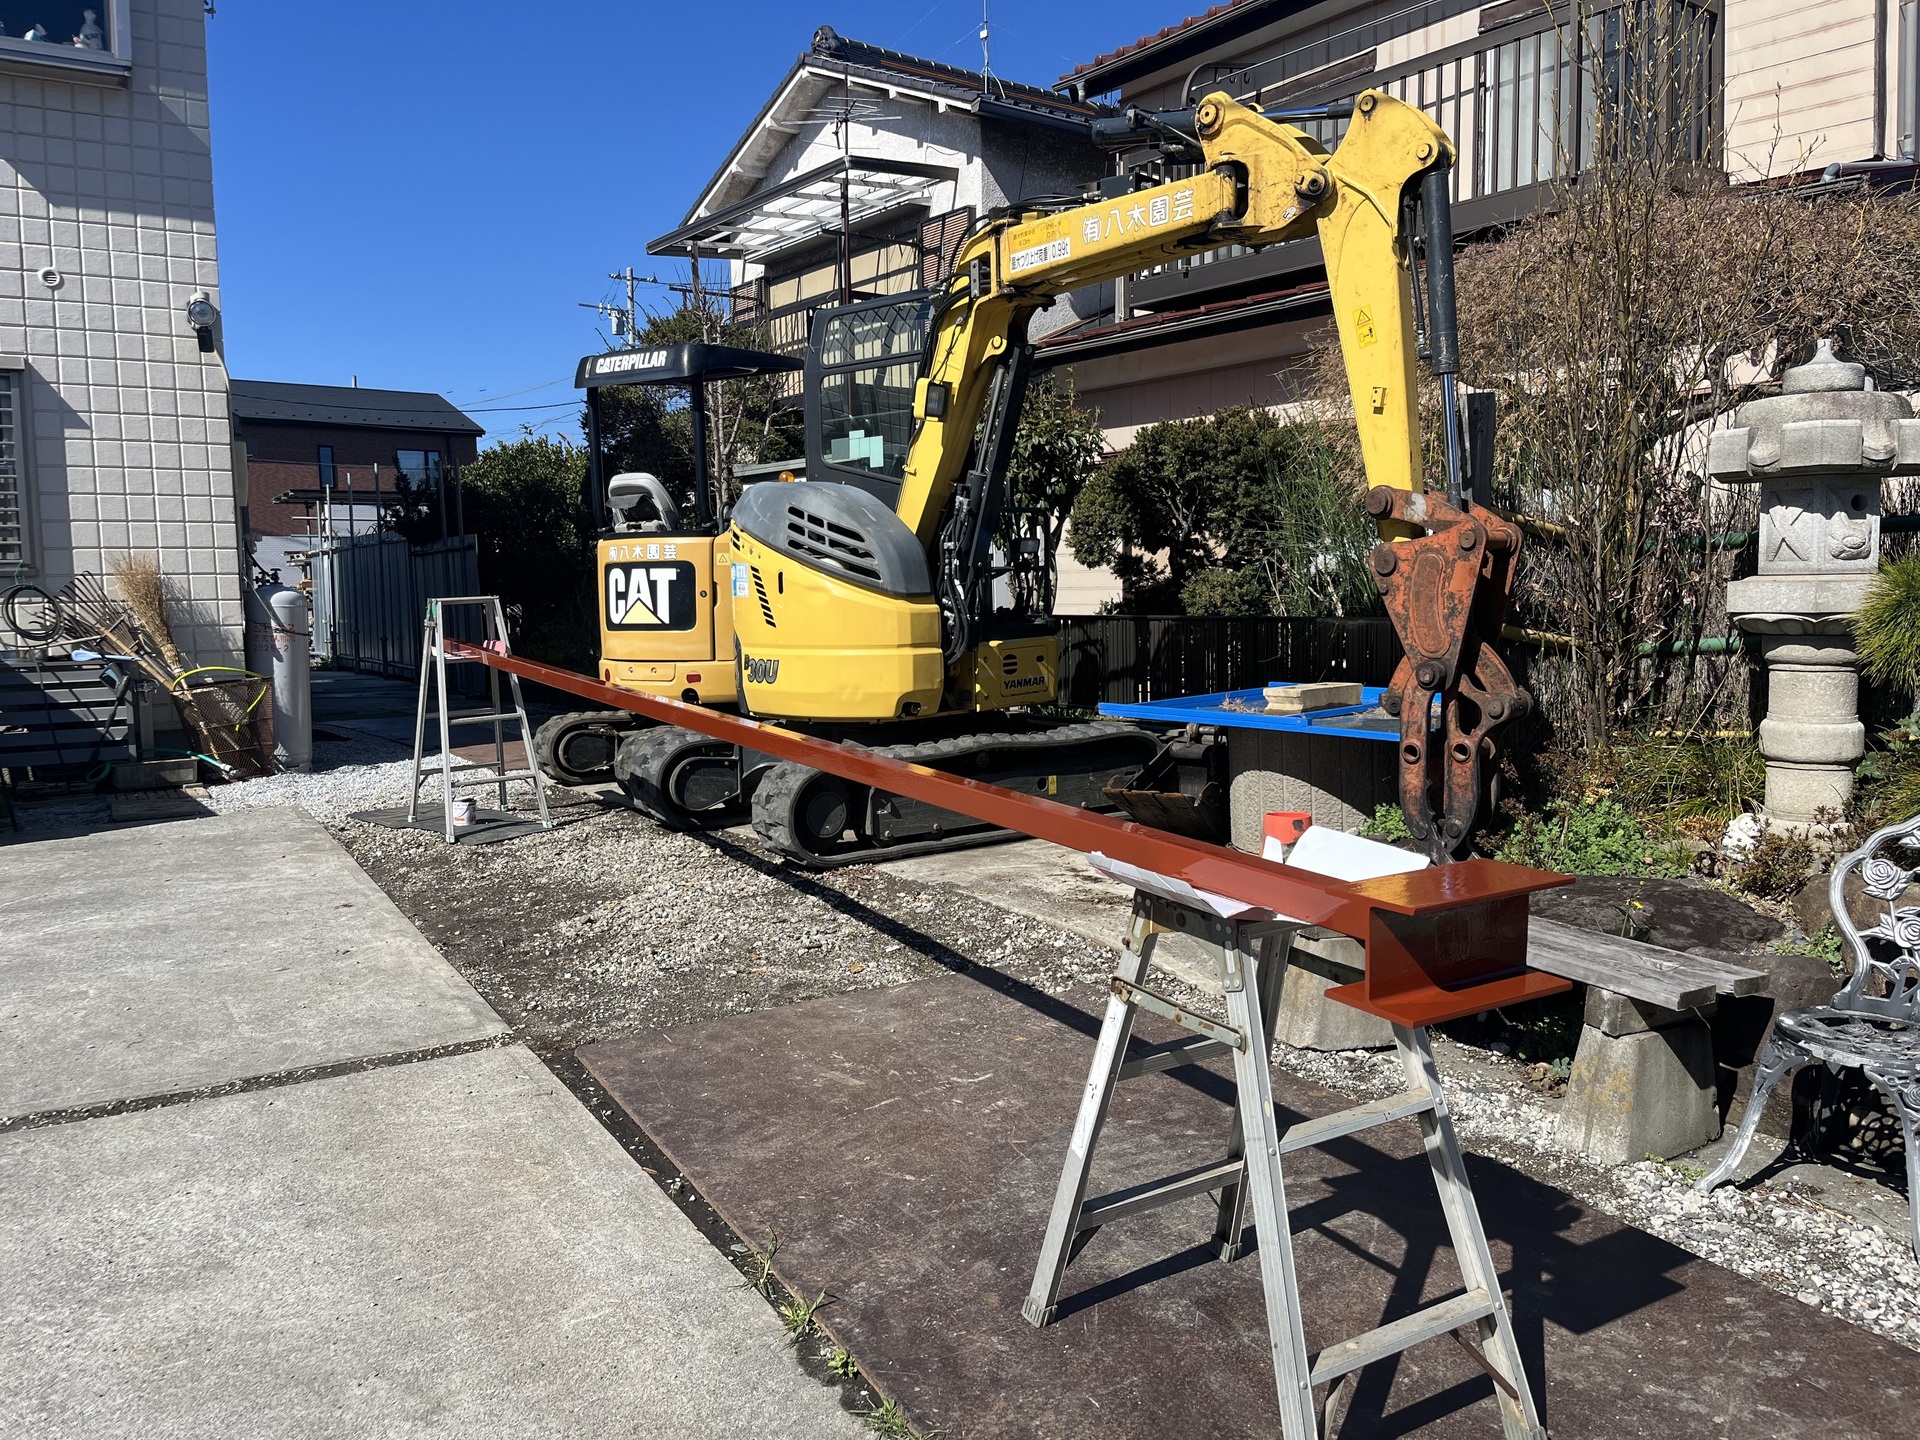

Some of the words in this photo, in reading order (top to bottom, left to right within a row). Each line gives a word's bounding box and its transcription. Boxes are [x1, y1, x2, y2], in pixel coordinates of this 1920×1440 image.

[595, 350, 668, 374] CATERPILLAR
[608, 567, 677, 625] CAT
[1003, 676, 1045, 690] YANMAR
